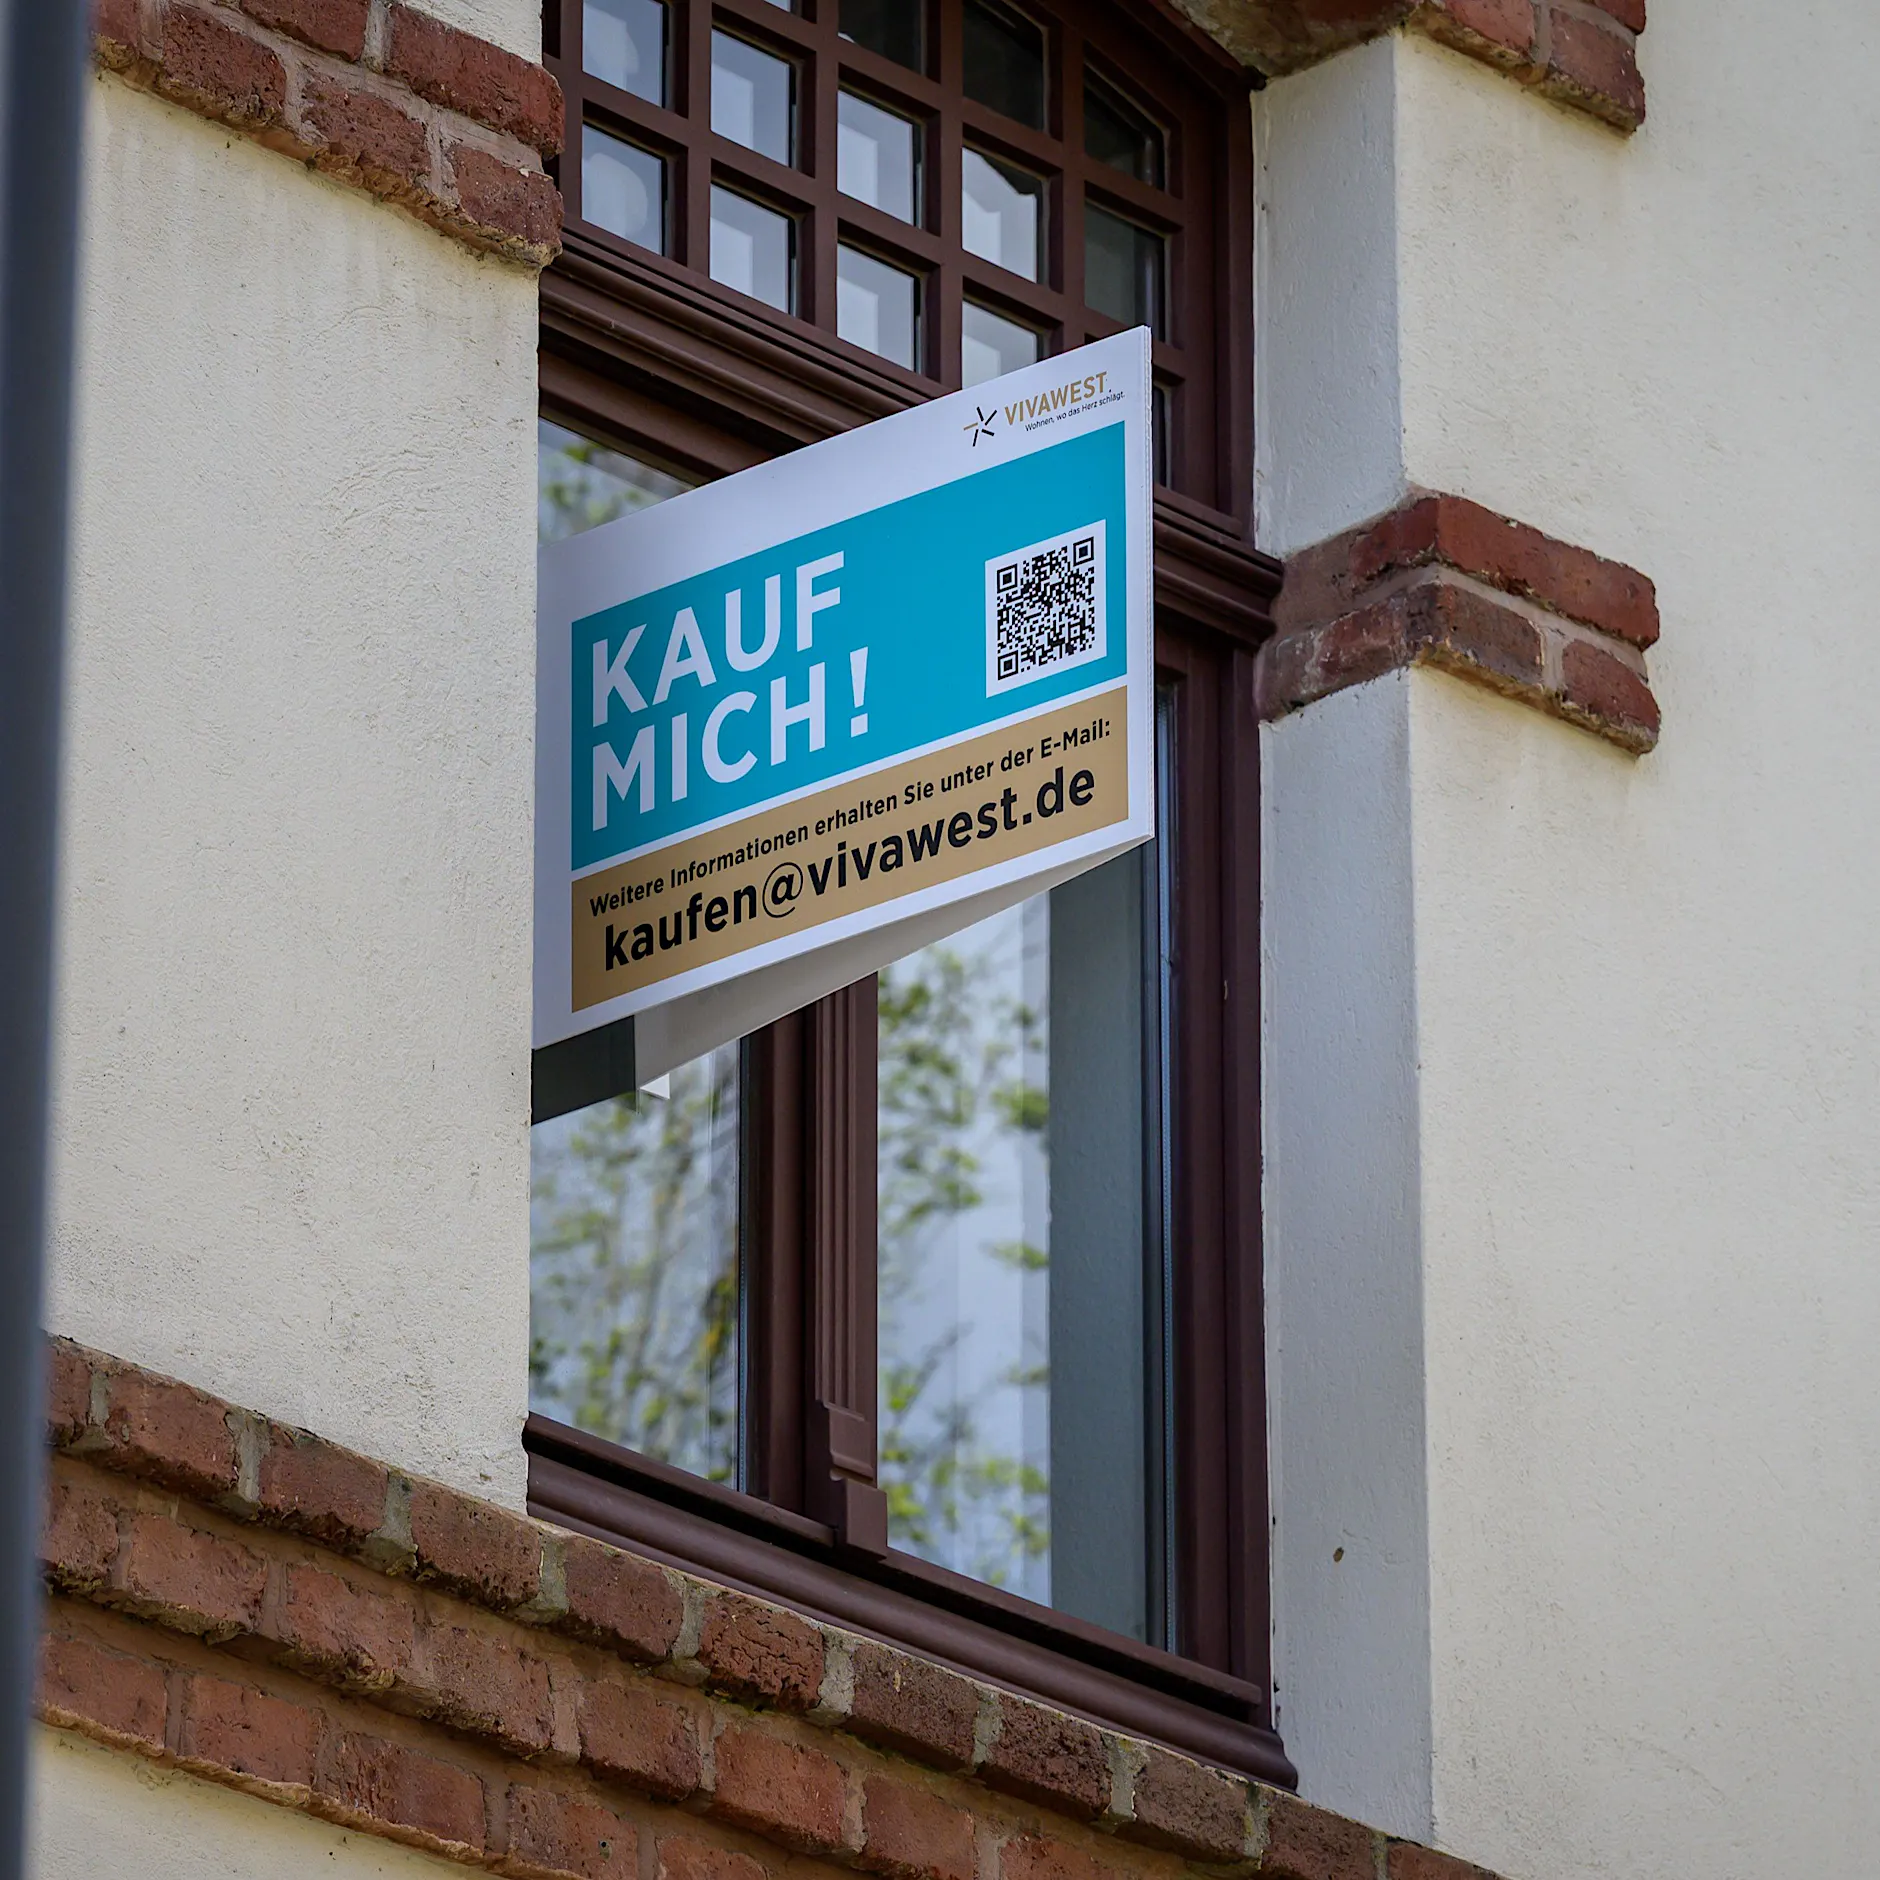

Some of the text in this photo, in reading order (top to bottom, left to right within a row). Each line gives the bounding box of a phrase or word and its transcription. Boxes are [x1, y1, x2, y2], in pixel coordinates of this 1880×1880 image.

[1025, 417, 1055, 431] Wohnen,
[1056, 412, 1067, 420] wo
[1068, 407, 1080, 417] das
[1081, 401, 1097, 412] Herz
[593, 550, 844, 727] KAUF
[590, 718, 1110, 916] Weitere Informationen erhalten Sie unter der E-Mail:
[593, 646, 868, 831] MICH!
[605, 766, 1095, 971] kaufen@vivawest.de
